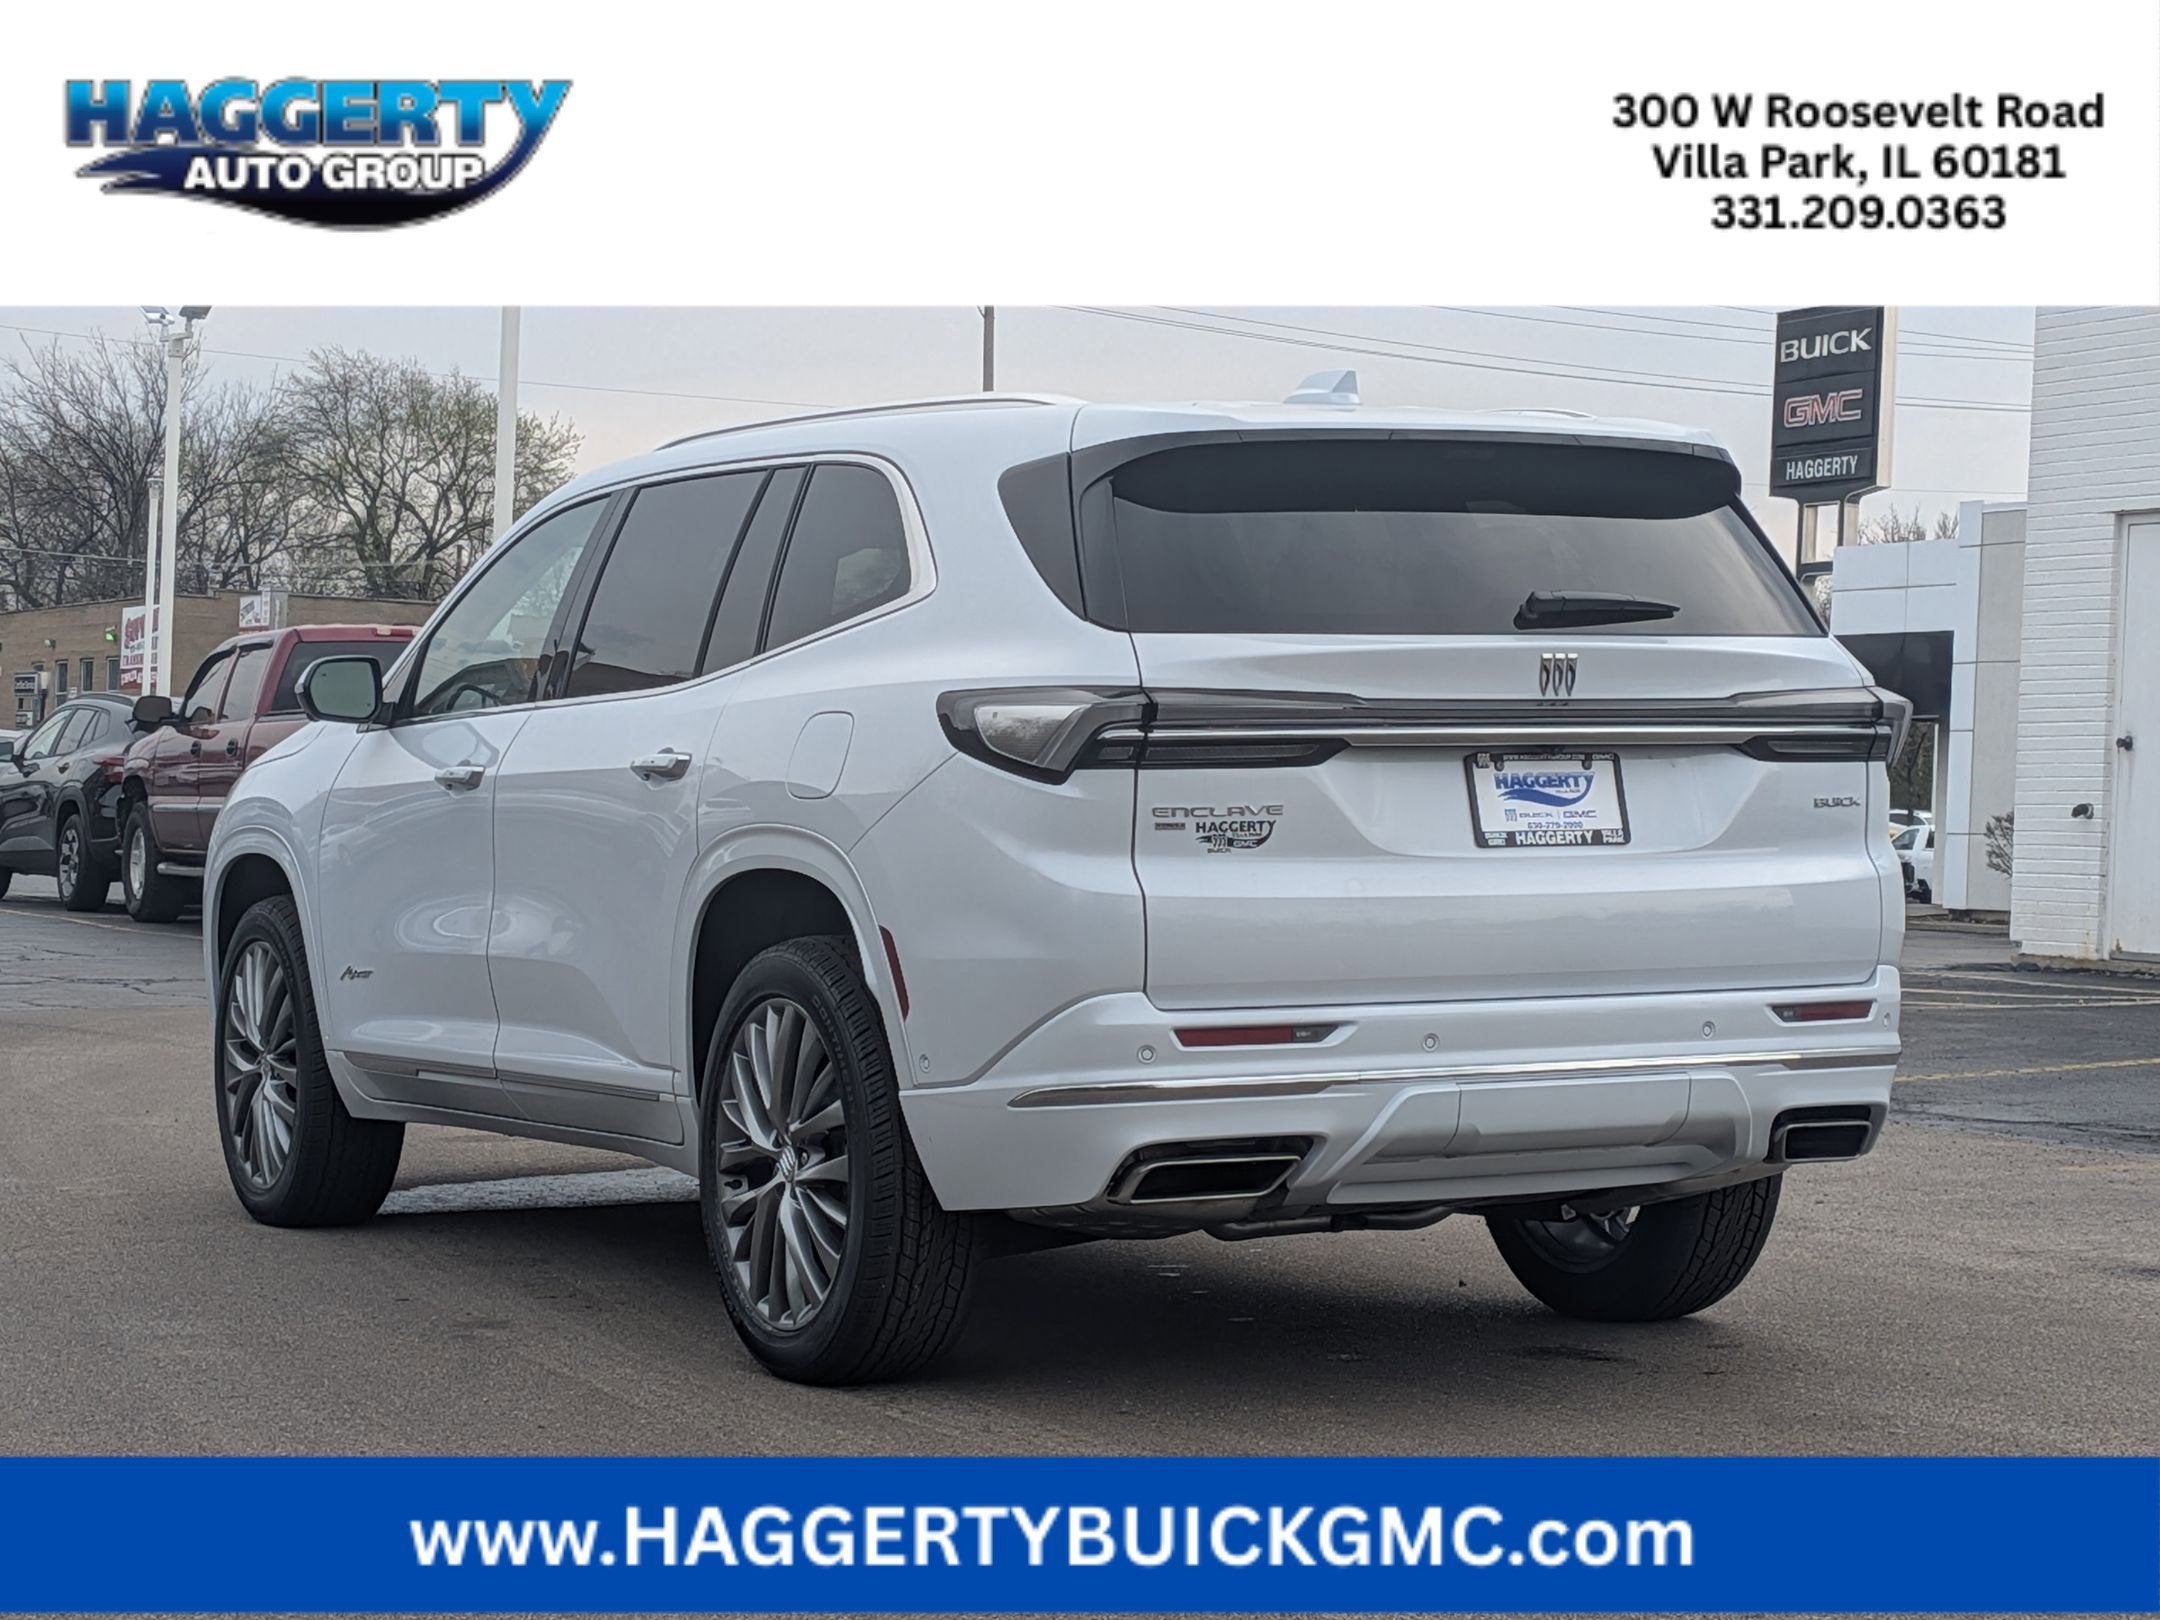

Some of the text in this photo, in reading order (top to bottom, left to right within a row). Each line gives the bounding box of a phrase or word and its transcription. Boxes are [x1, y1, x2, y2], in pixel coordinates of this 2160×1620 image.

[1780, 328, 1872, 363] BUICK
[1783, 389, 1863, 428] GMC
[1785, 455, 1858, 480] HAGGERTY
[1494, 772, 1595, 790] HAGGERTY
[1813, 797, 1860, 808] BUICK
[1152, 805, 1284, 818] ENCLAVE
[1563, 810, 1597, 818] GMC
[1195, 820, 1277, 834] HAGGERTY
[1515, 830, 1593, 845] HAGGERTY
